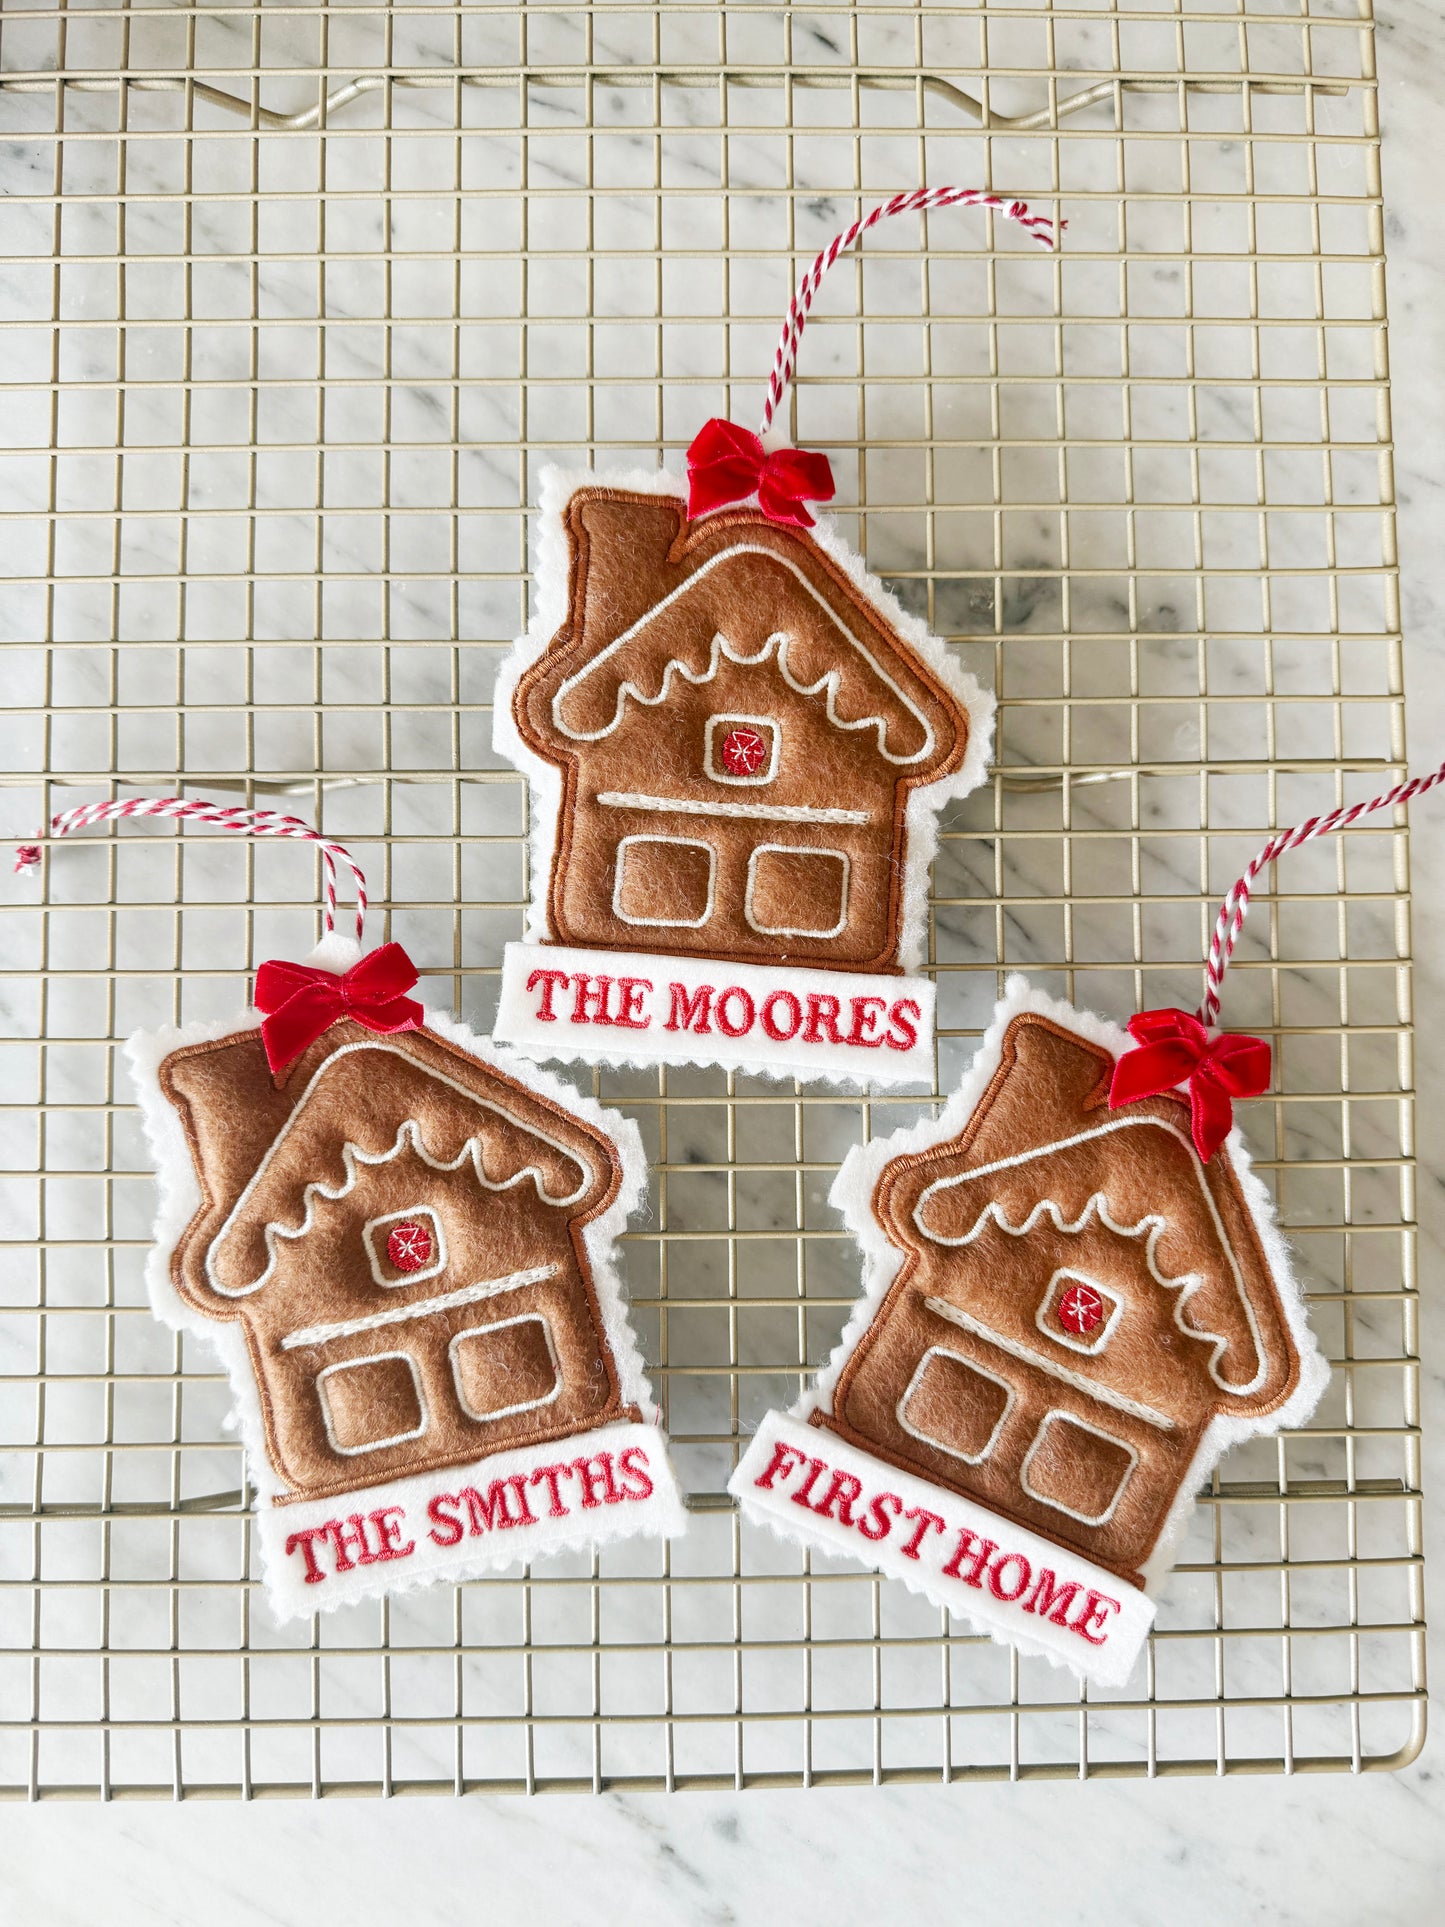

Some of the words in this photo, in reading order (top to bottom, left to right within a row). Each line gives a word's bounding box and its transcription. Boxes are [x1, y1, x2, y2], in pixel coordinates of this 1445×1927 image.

[526, 968, 654, 1029] THE
[663, 981, 921, 1052] MOORES
[285, 1506, 415, 1584] THE
[426, 1447, 654, 1546] SMITHS
[754, 1442, 947, 1560] FIRST
[942, 1528, 1121, 1645] HOME
